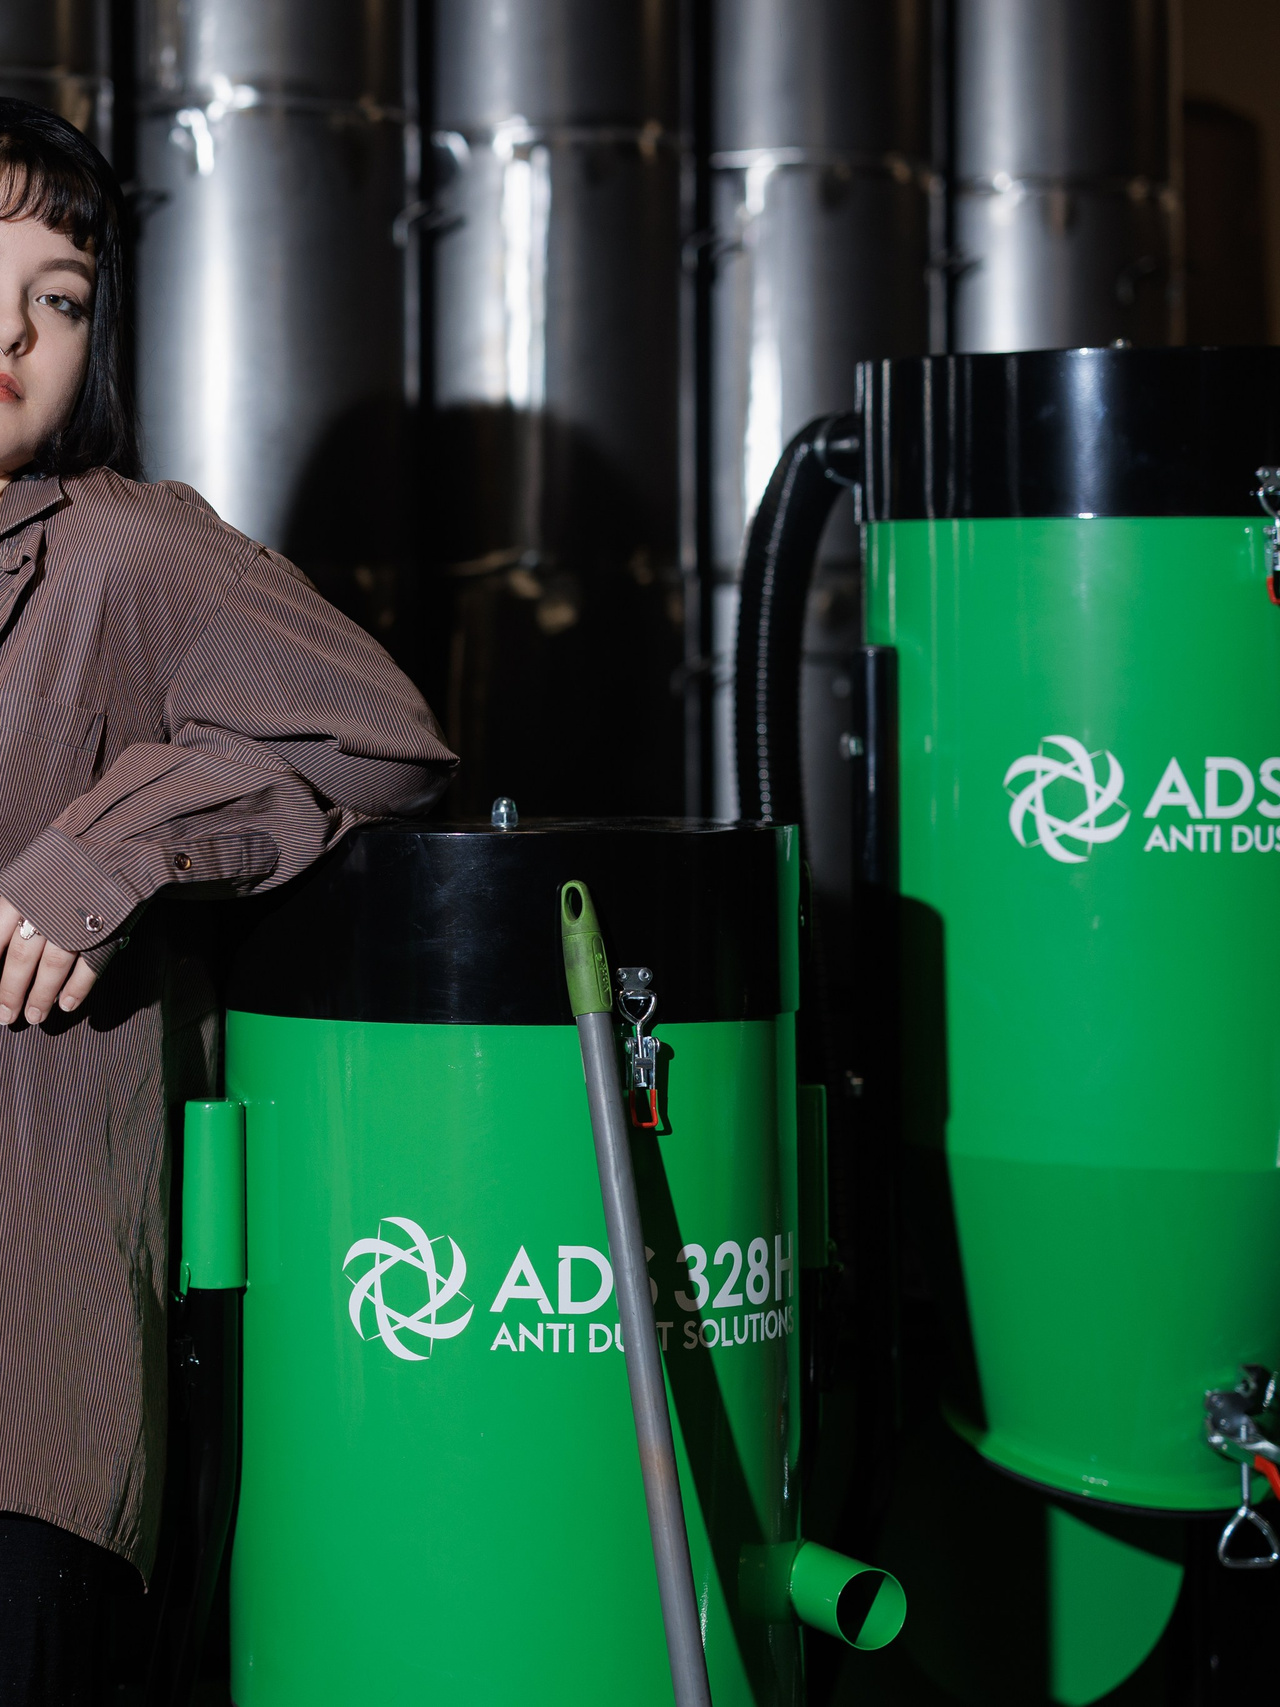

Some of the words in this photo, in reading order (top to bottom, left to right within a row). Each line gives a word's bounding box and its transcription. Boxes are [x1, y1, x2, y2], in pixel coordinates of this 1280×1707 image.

[1143, 756, 1280, 819] ADS
[1144, 824, 1221, 853] ANTI
[489, 1244, 659, 1315] AD
[674, 1231, 794, 1312] 328H
[490, 1322, 575, 1354] ANTI
[683, 1305, 794, 1350] SOLUTIONS
